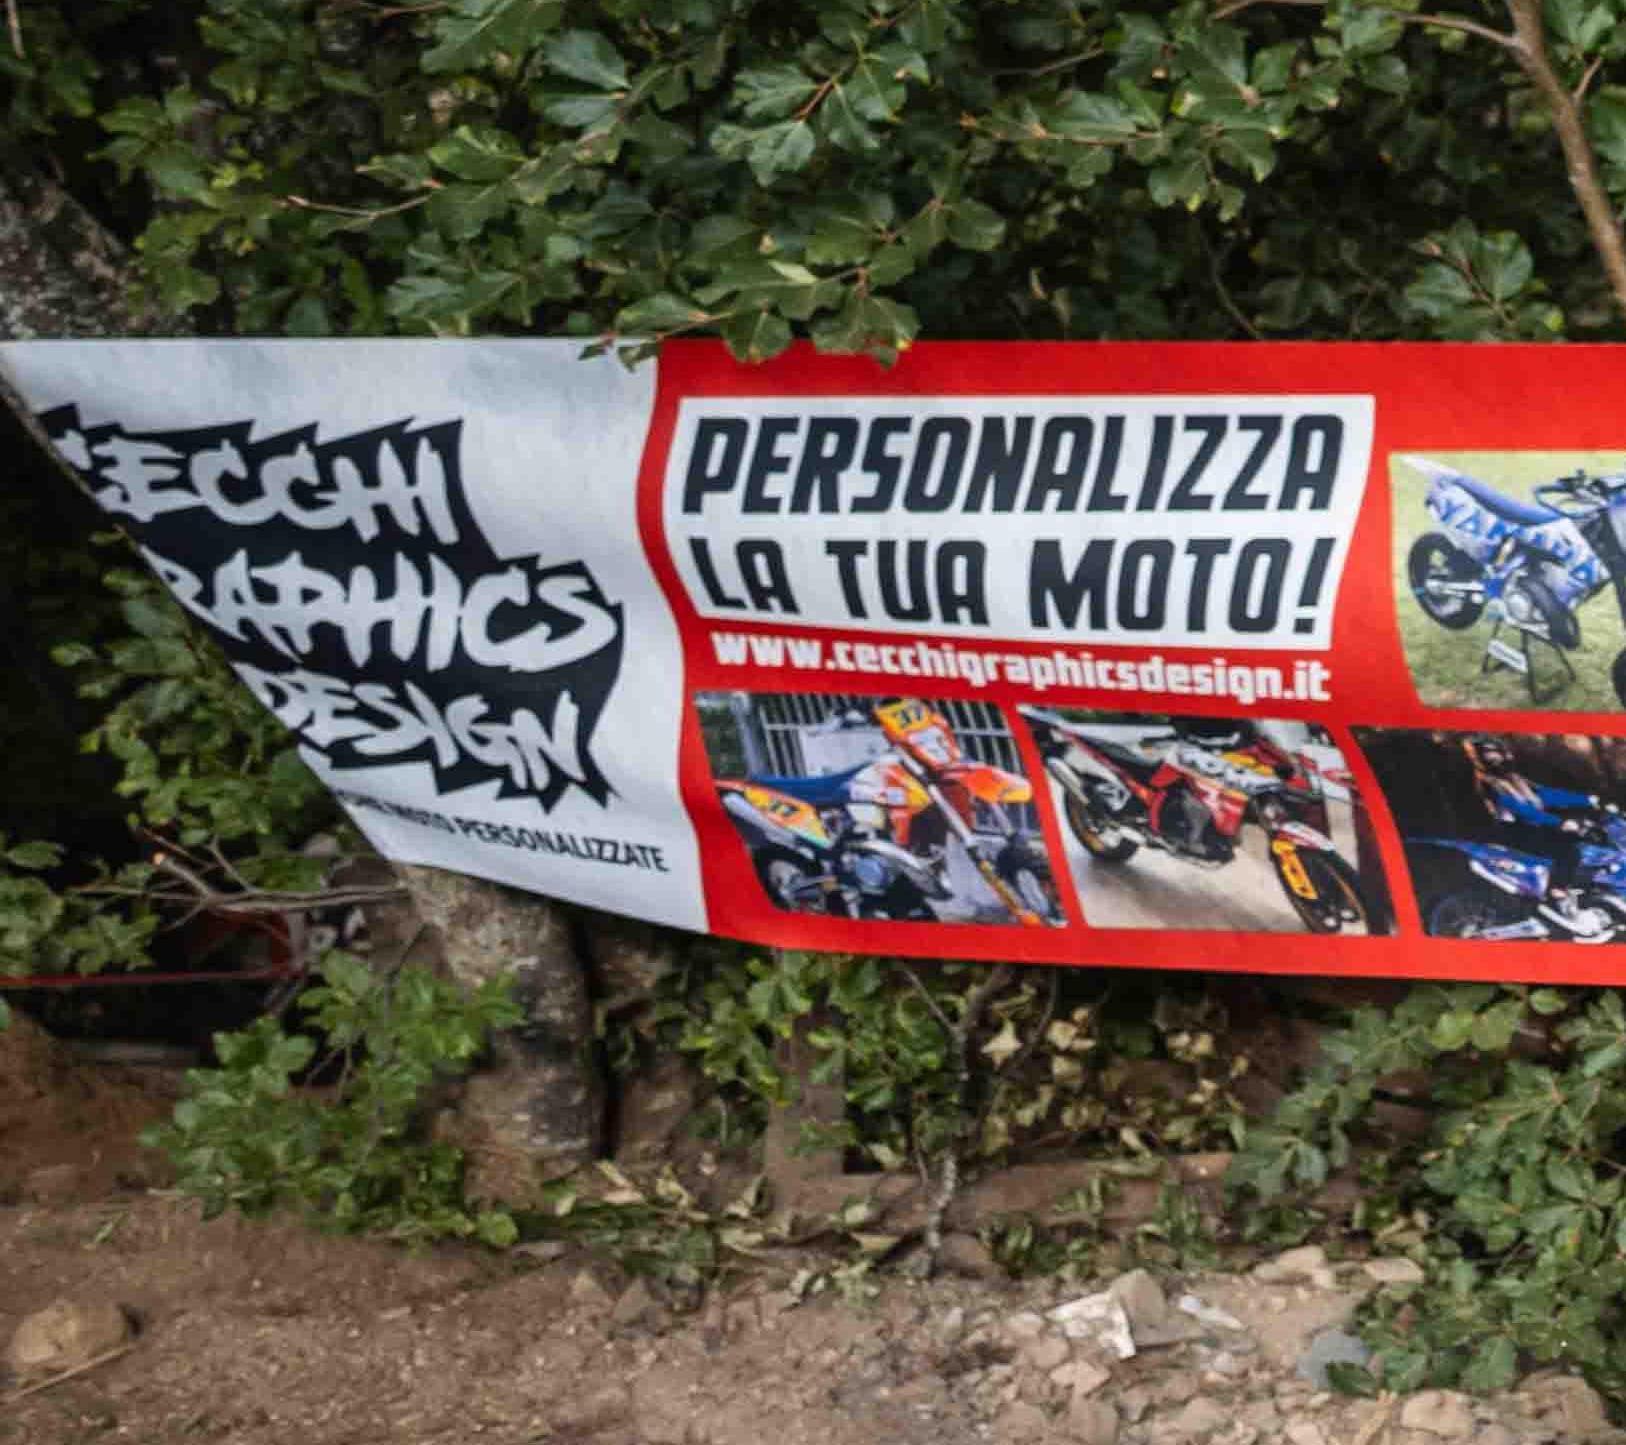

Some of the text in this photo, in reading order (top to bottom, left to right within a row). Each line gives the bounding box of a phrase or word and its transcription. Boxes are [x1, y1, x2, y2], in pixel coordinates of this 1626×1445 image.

[682, 414, 1345, 514] PERSONALIZZA
[689, 536, 1336, 633] LA TUA MOTO!
[709, 630, 1331, 703] www.cecchigraphicsdesign.it
[453, 816, 670, 871] PERSONALIZZATE
